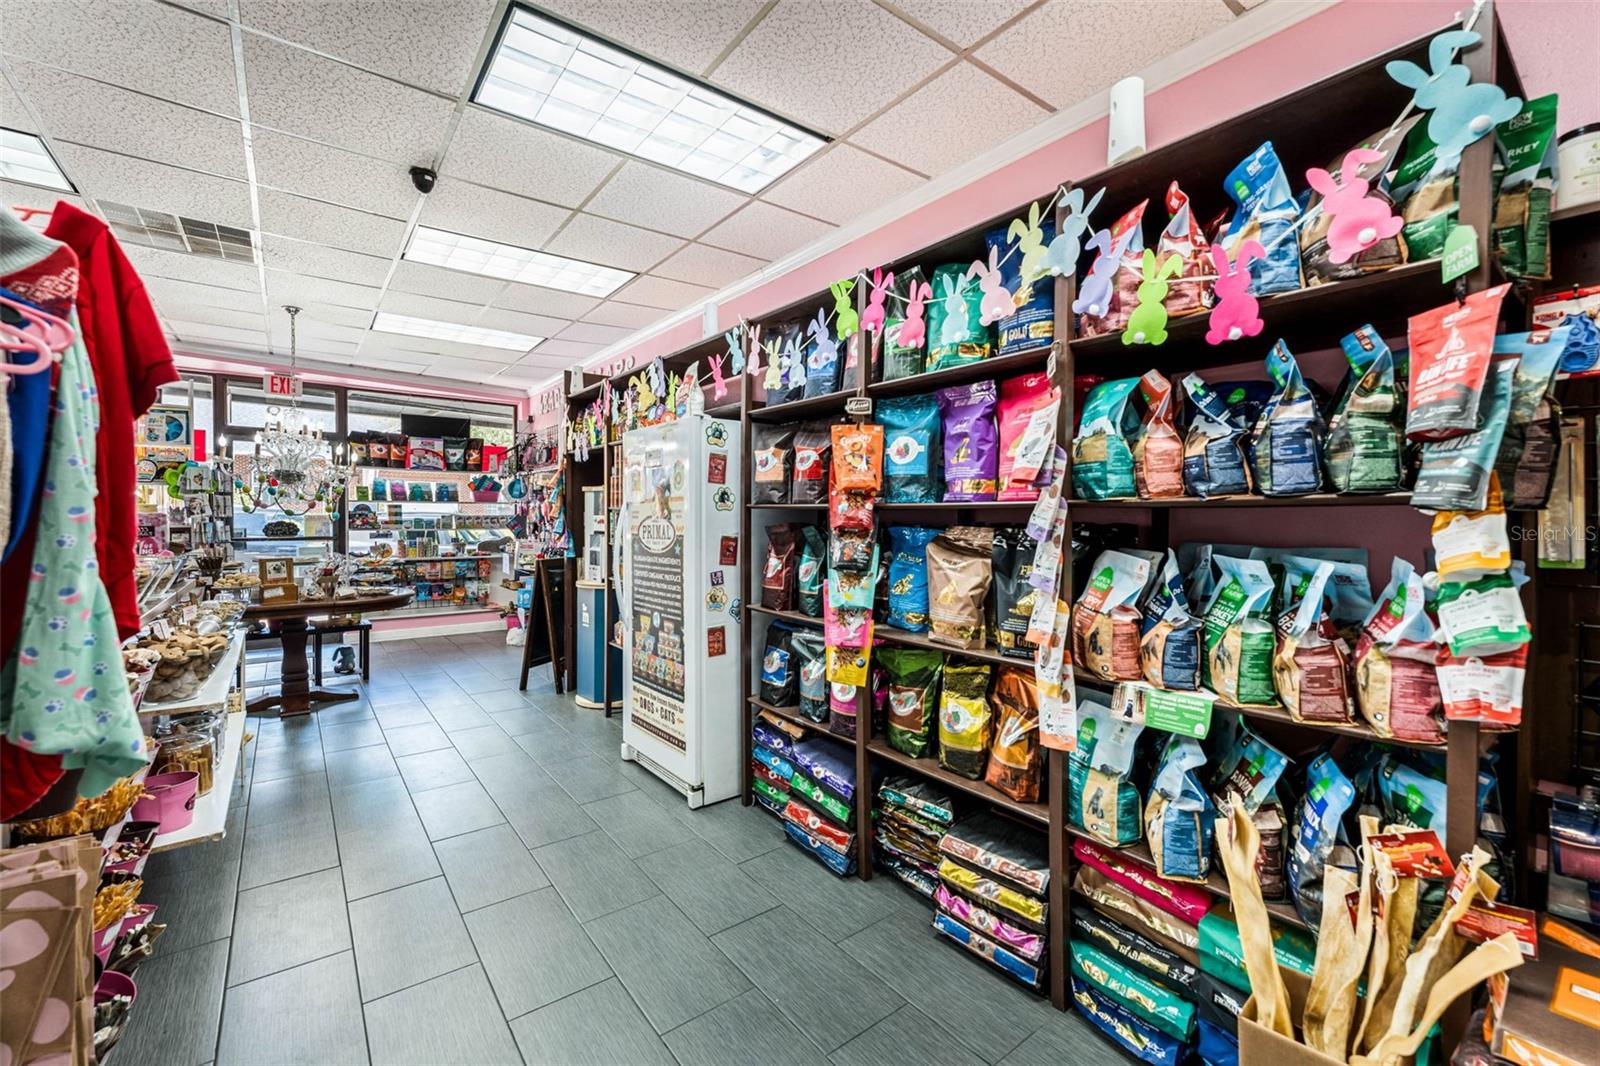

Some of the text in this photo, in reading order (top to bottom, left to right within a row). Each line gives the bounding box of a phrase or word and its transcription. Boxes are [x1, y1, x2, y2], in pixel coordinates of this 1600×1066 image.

[1507, 141, 1540, 157] RKEY
[1444, 245, 1474, 265] OPEN
[1446, 255, 1474, 277] FARM
[1535, 312, 1557, 321] KONG
[1008, 324, 1028, 341] GOLD
[642, 524, 672, 541] PRIMAL
[1278, 616, 1294, 633] BE
[639, 696, 676, 725] DOGS CATS
